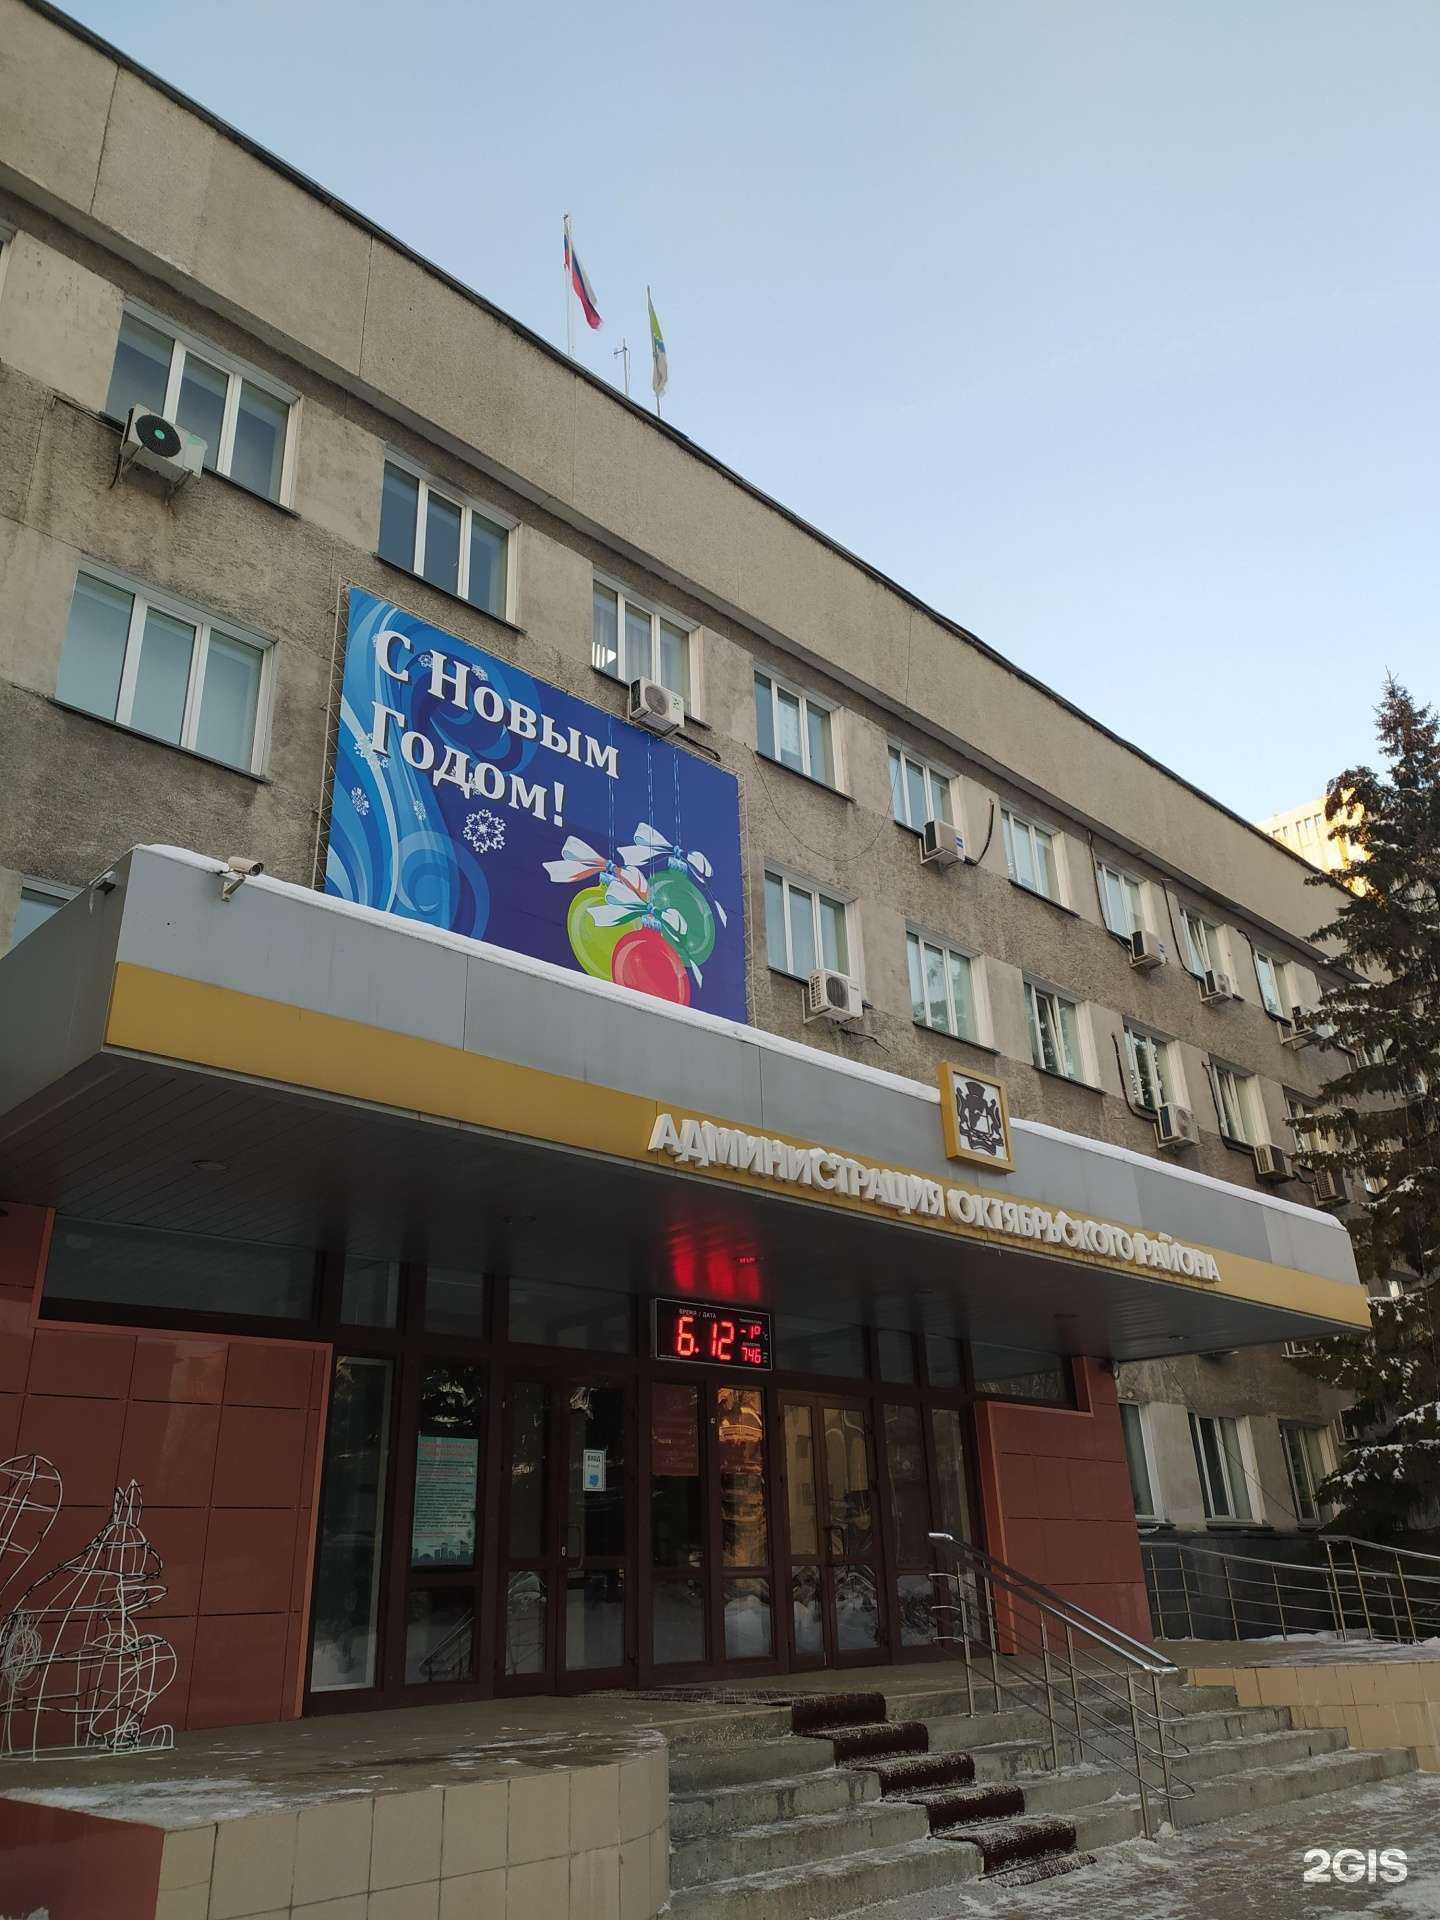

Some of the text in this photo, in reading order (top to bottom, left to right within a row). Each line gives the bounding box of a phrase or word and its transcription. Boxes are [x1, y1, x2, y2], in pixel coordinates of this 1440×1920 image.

[370, 700, 565, 828] Годом!
[375, 630, 620, 780] С Новым
[648, 1113, 1222, 1283] АДМИНИСТРАЦИЯ ОКТЯБРЬСКОГО РАЙОНА
[702, 1311, 717, 1319] ДАТА
[741, 1347, 762, 1364] 746
